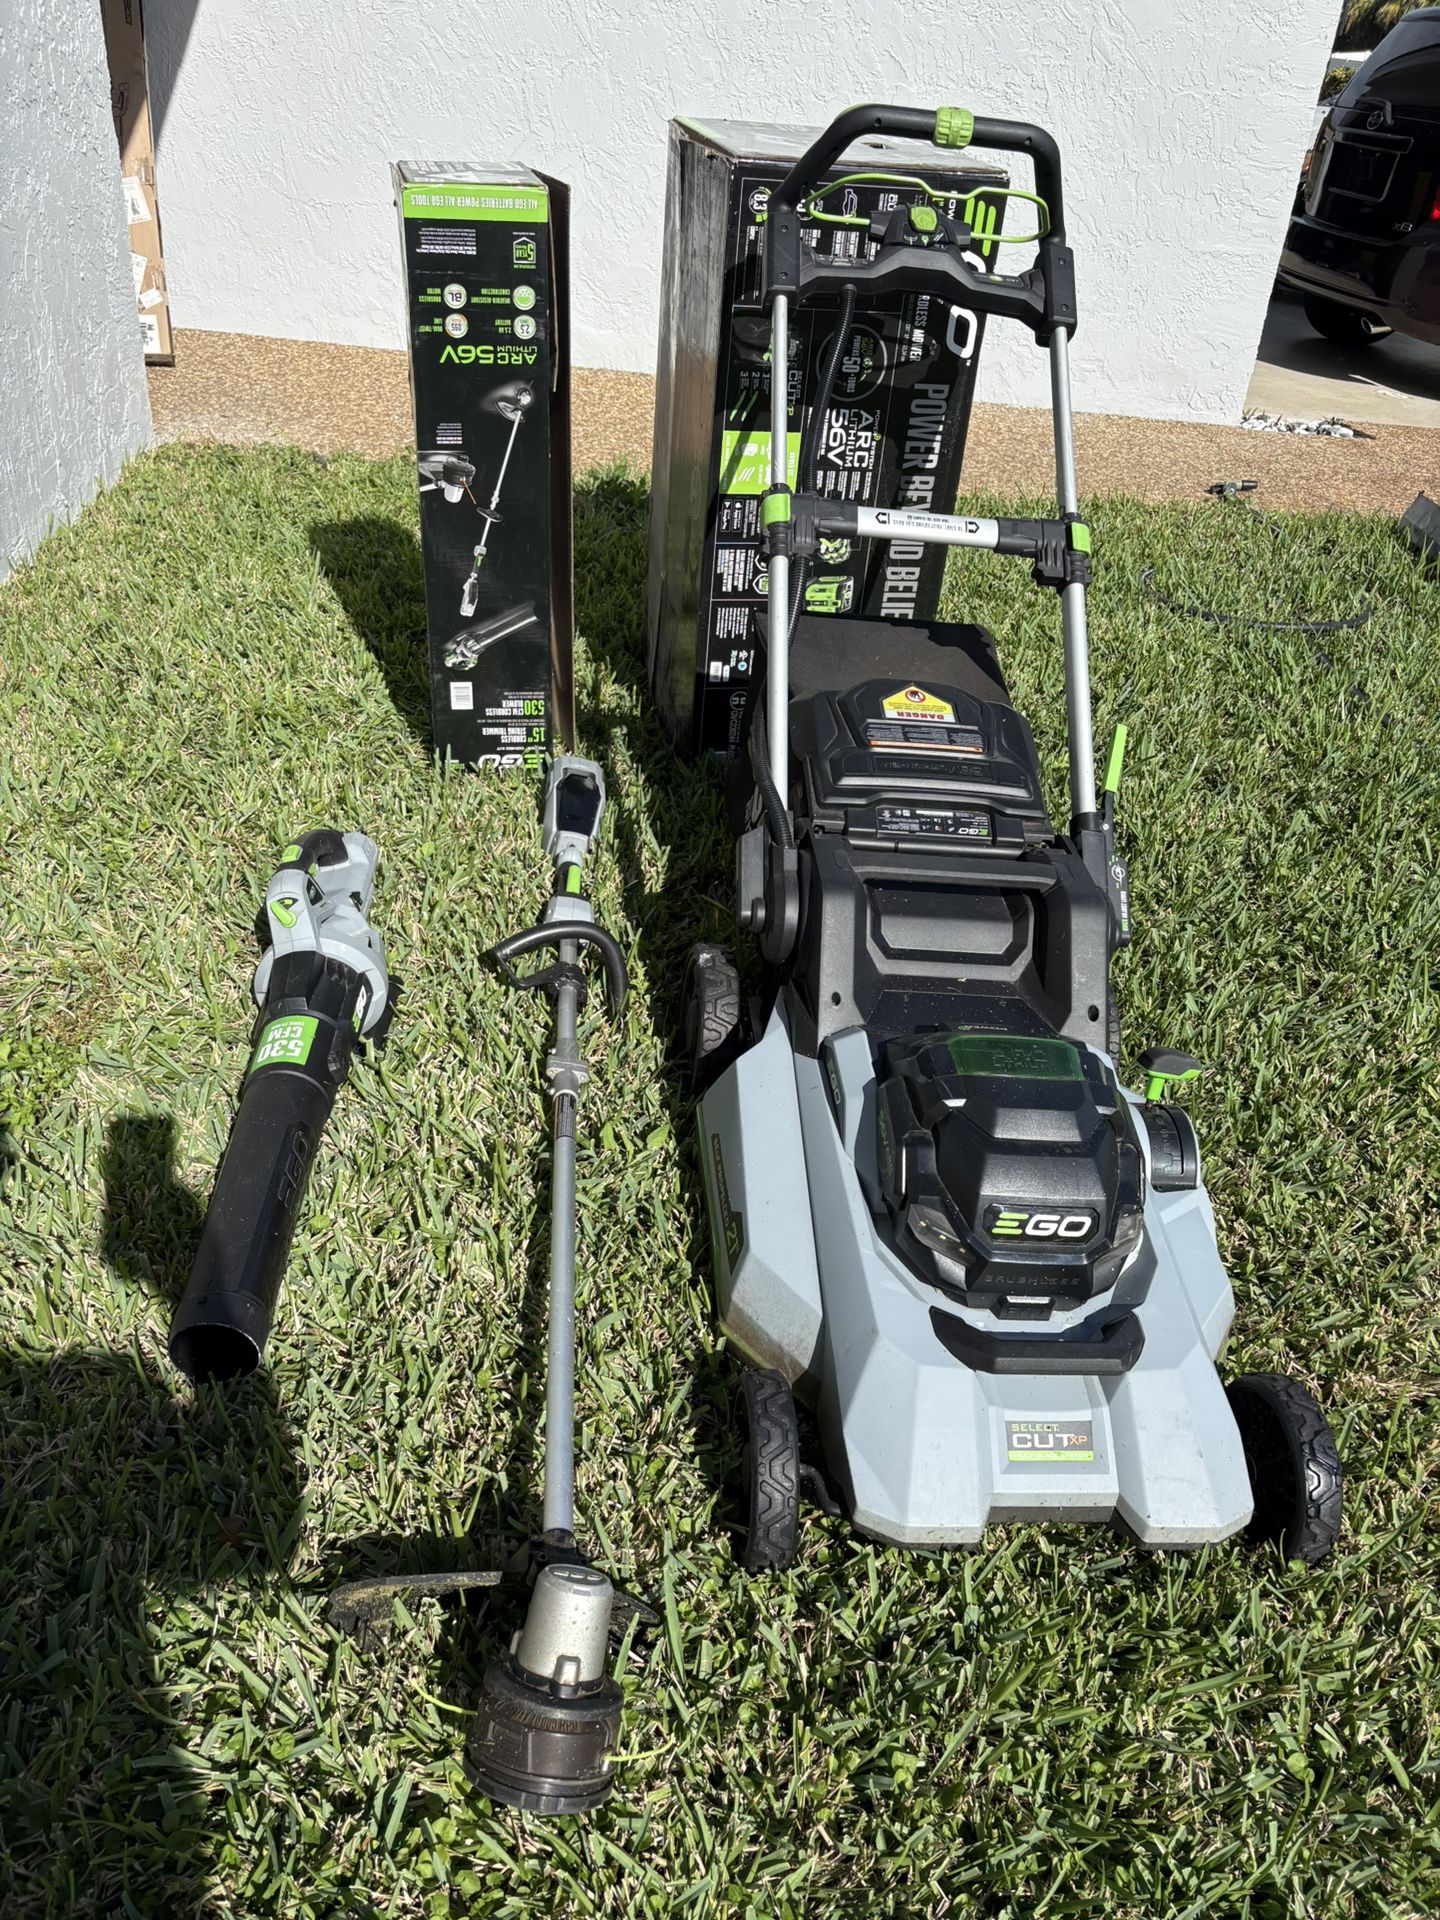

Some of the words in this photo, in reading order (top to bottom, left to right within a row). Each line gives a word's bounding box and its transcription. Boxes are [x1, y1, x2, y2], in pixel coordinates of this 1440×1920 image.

[411, 194, 430, 206] TOOLS
[431, 195, 444, 207] EGO
[444, 195, 456, 207] ALL
[457, 196, 480, 208] POWER
[480, 197, 513, 209] BATTERIES
[514, 198, 527, 209] EGO
[528, 199, 539, 210] ALL
[527, 243, 534, 261] 5
[448, 292, 462, 303] BL
[913, 295, 931, 327] RDLESS
[496, 345, 538, 354] LITHIUM
[909, 329, 925, 363] MOWER
[439, 345, 495, 364] 56V
[497, 352, 538, 365] ARC
[787, 370, 798, 404] CUT
[902, 383, 950, 470] POWER
[827, 408, 850, 467] 56V
[844, 408, 859, 468] LITHIUM
[853, 409, 874, 468] ARC
[868, 441, 877, 470] SYSTEM
[889, 475, 936, 560] BEYD
[880, 566, 922, 620] BELIE
[502, 700, 524, 709] BLOWER
[524, 700, 545, 716] 530
[485, 708, 512, 717] CORDLESS
[512, 708, 524, 716] CFM
[896, 711, 945, 721] DANGER
[482, 727, 507, 736] TRIMMER
[507, 727, 527, 736] STRING
[527, 727, 545, 743] 15"
[501, 735, 527, 743] CORDLESS
[958, 827, 989, 837] EGO
[266, 1026, 304, 1043] CFM
[257, 1039, 305, 1064] 530
[717, 1164, 731, 1226] PROPELLED
[991, 1211, 1093, 1238] EGO
[984, 1274, 1081, 1286] BRUSHLESS
[1011, 1423, 1060, 1432] SELECT
[1012, 1433, 1075, 1448] CUT
